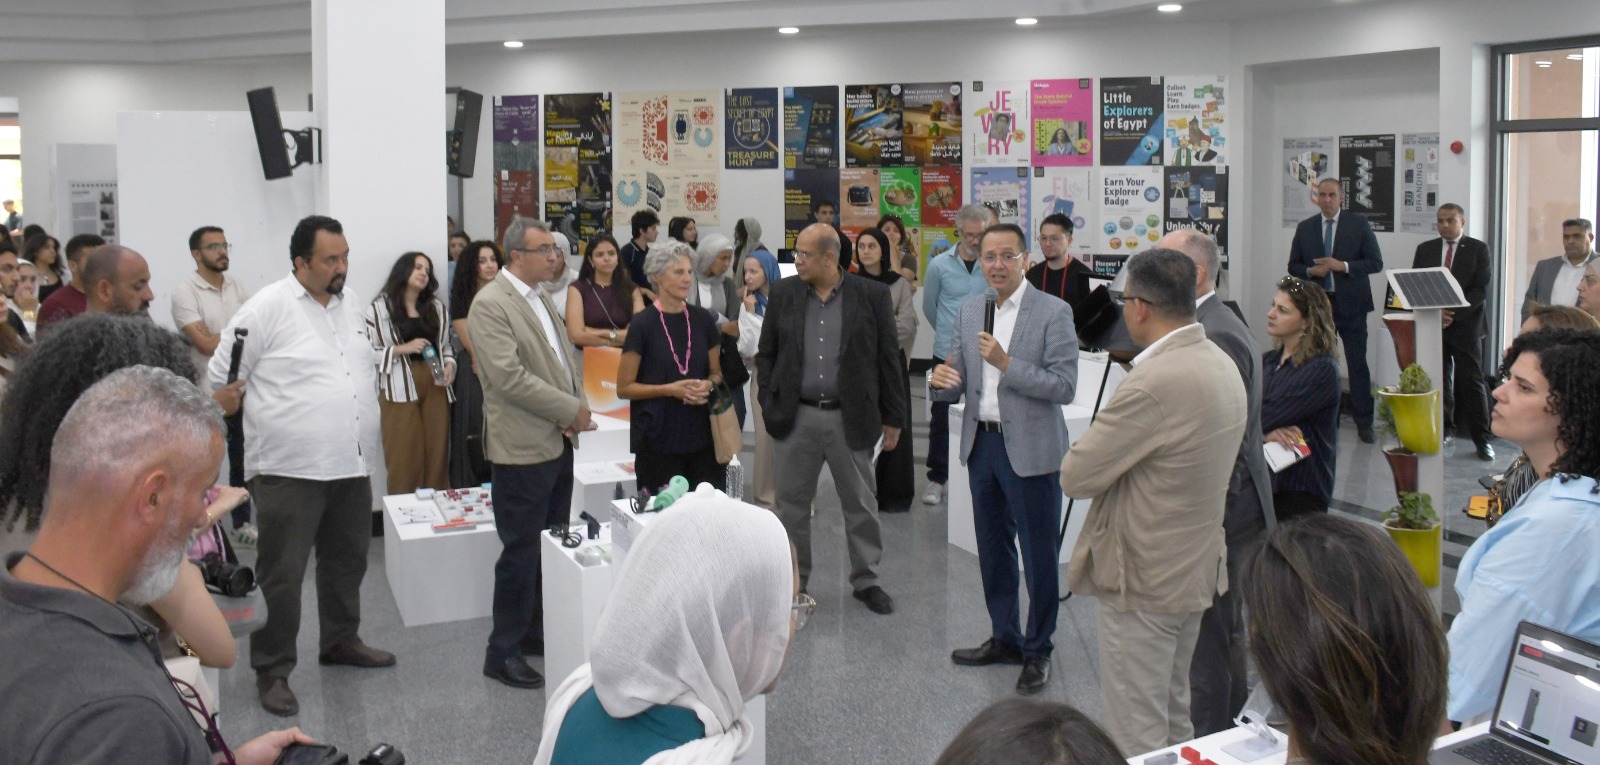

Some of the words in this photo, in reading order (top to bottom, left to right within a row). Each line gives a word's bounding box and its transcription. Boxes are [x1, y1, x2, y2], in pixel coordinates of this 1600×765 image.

[727, 96, 738, 106] THE
[739, 96, 752, 106] LOST
[1104, 92, 1132, 104] Little
[727, 108, 746, 120] SECRET
[748, 108, 756, 120] OF
[758, 108, 774, 119] EGYPT
[1104, 105, 1153, 118] Explorers
[1104, 117, 1115, 129] of
[1117, 117, 1147, 132] Egypt
[546, 137, 554, 145] of
[555, 137, 580, 146] history
[727, 151, 775, 160] TREASURE
[728, 159, 754, 167] HUNT
[1104, 178, 1124, 186] Earn
[1126, 178, 1145, 186] Your
[1416, 162, 1424, 212] BRANDING
[1104, 187, 1140, 198] Explorer
[1104, 197, 1130, 208] Badge
[1166, 222, 1196, 231] Unlock
